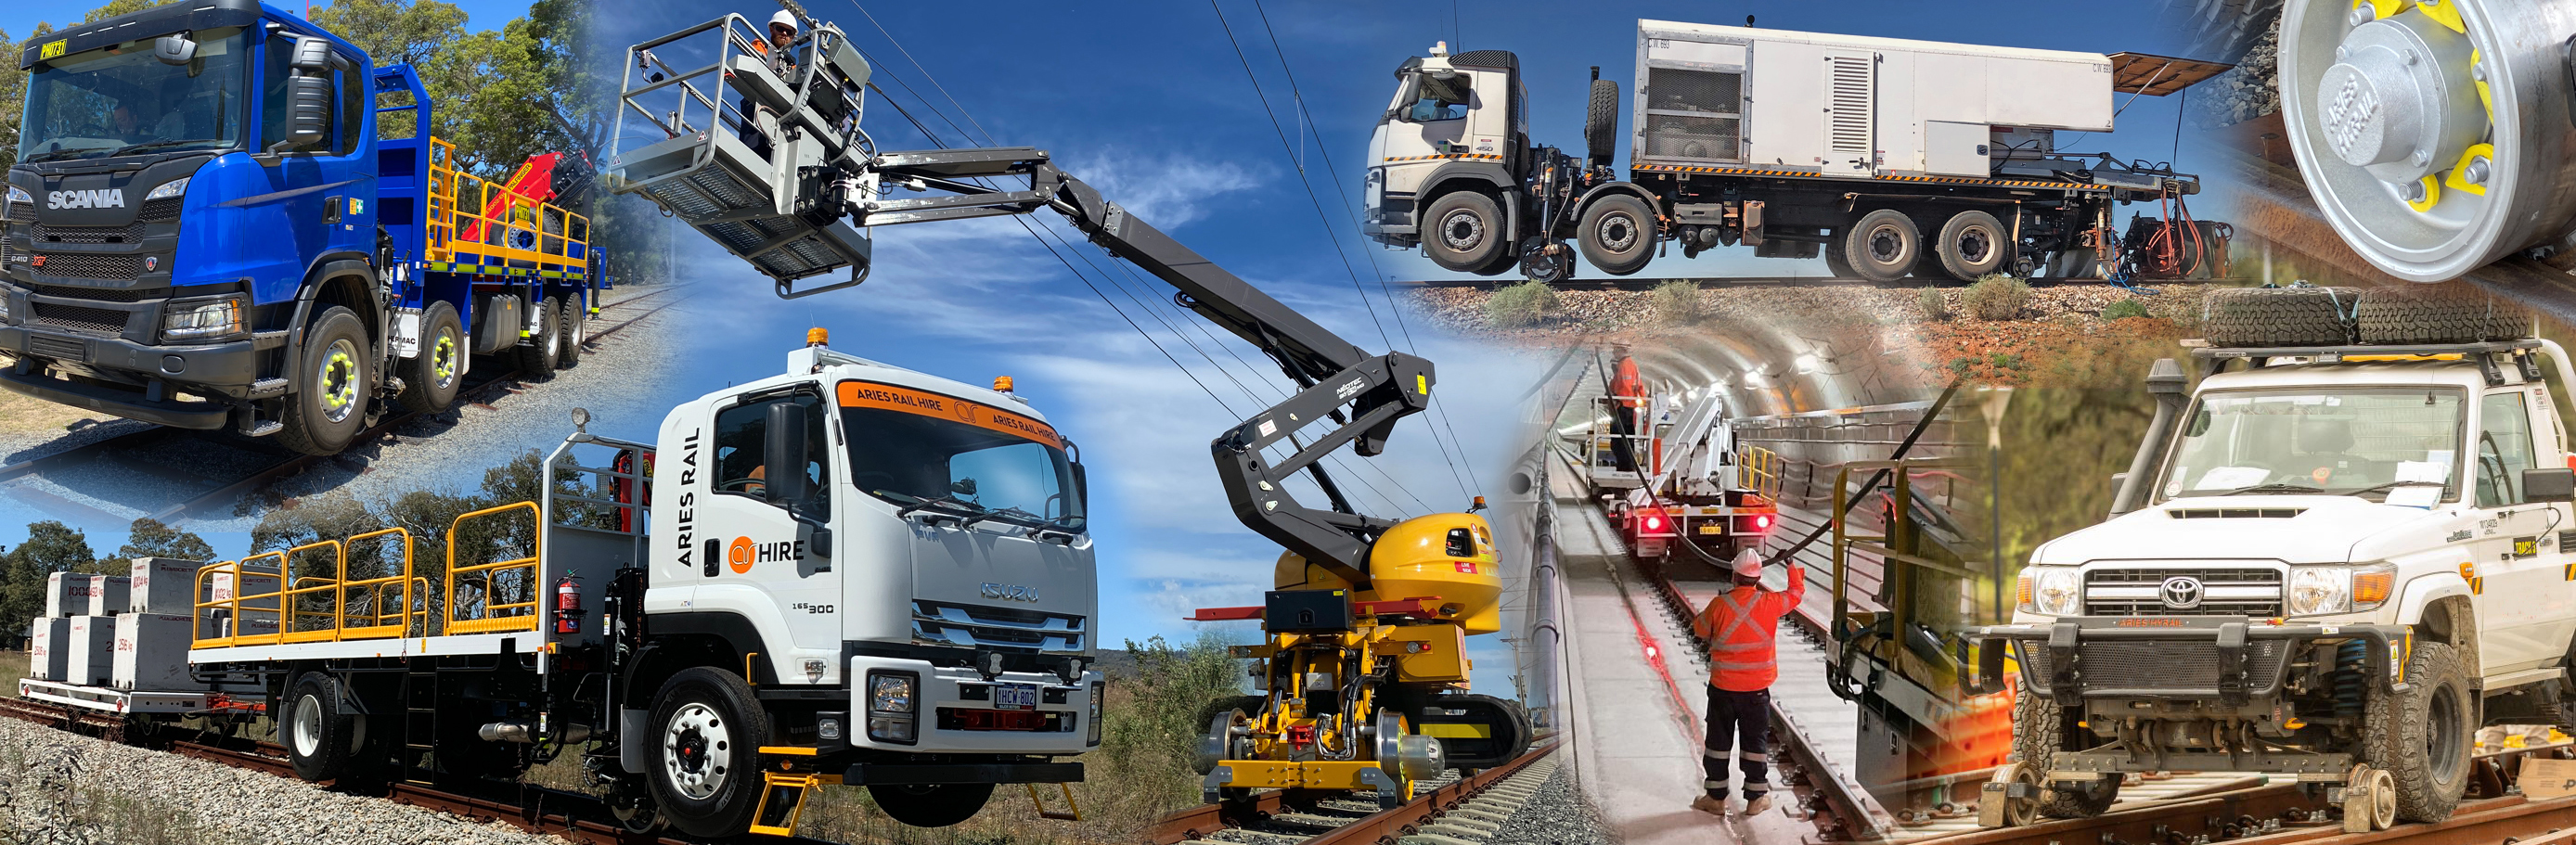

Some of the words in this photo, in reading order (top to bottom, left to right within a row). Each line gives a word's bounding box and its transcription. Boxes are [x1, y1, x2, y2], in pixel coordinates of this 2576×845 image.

[2327, 73, 2358, 134] ARIES
[507, 164, 532, 191] PALFINGER
[47, 189, 124, 210] SCANIA
[857, 389, 891, 403] ARIES
[892, 392, 918, 407] RAIL
[919, 398, 943, 412] HIRE
[993, 414, 1019, 429] ARIES
[1020, 420, 1037, 436] RAIL
[1037, 426, 1056, 442] HIRE
[680, 427, 700, 486] RAIL
[677, 492, 694, 568] ARIES
[758, 540, 805, 563] HIRE
[980, 582, 1038, 603] ISUZU
[808, 605, 833, 614] 300
[2119, 618, 2147, 627] ARIES
[2149, 617, 2183, 627] HYRAIL
